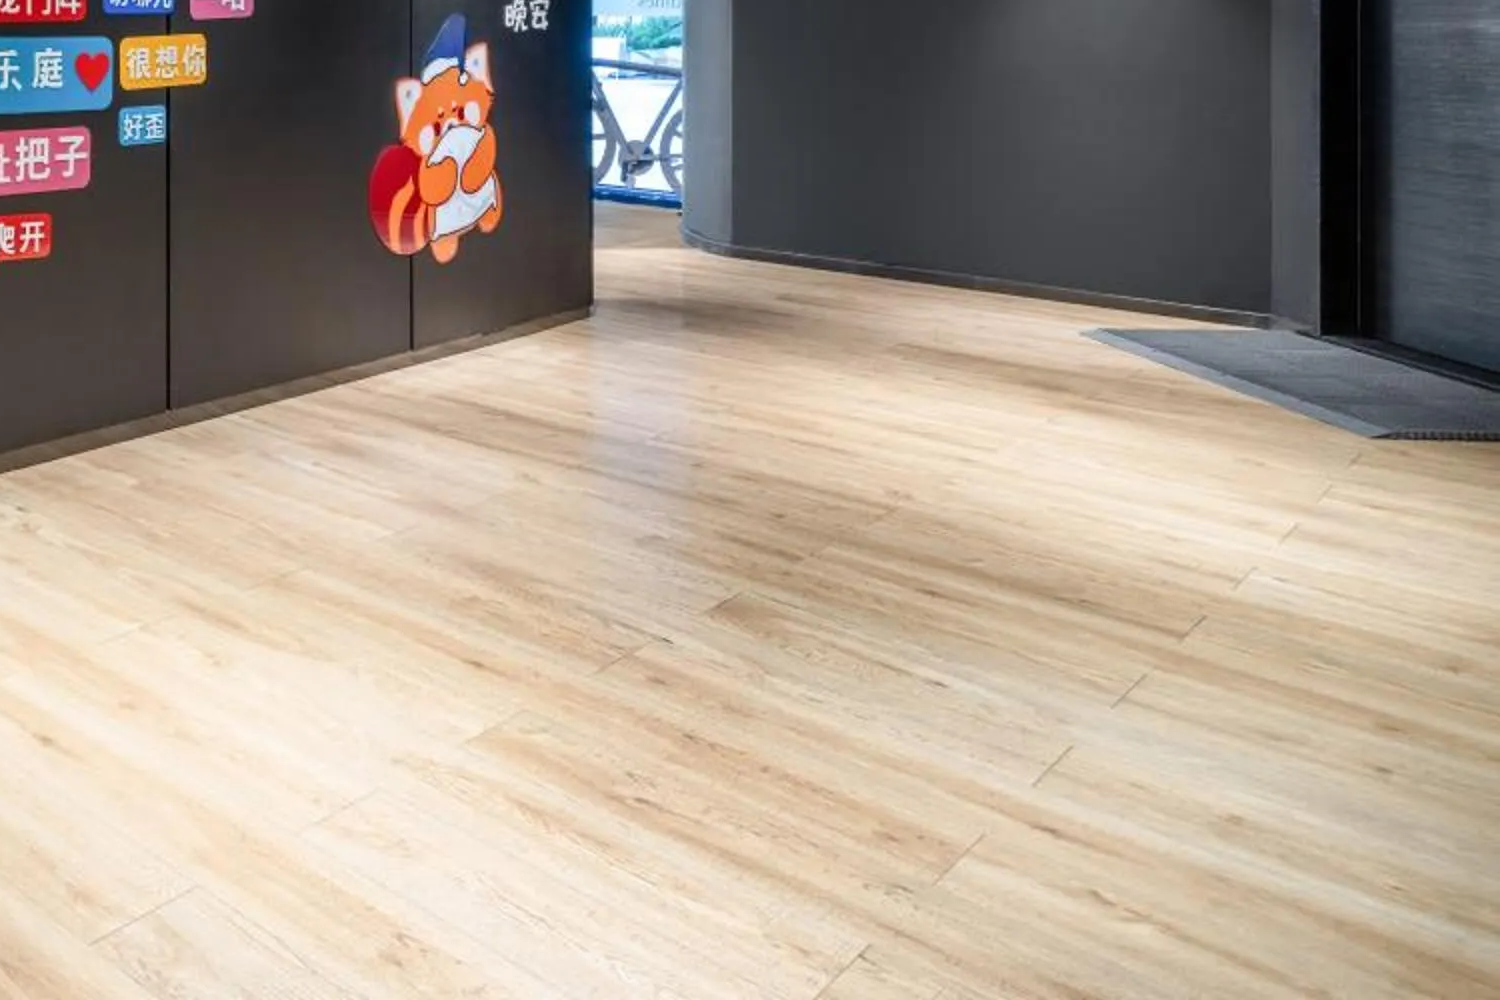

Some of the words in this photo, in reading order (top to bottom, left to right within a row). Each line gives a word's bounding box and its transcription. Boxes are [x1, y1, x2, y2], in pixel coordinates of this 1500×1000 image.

[127, 45, 205, 78] 很想你
[124, 114, 164, 139] 好歪
